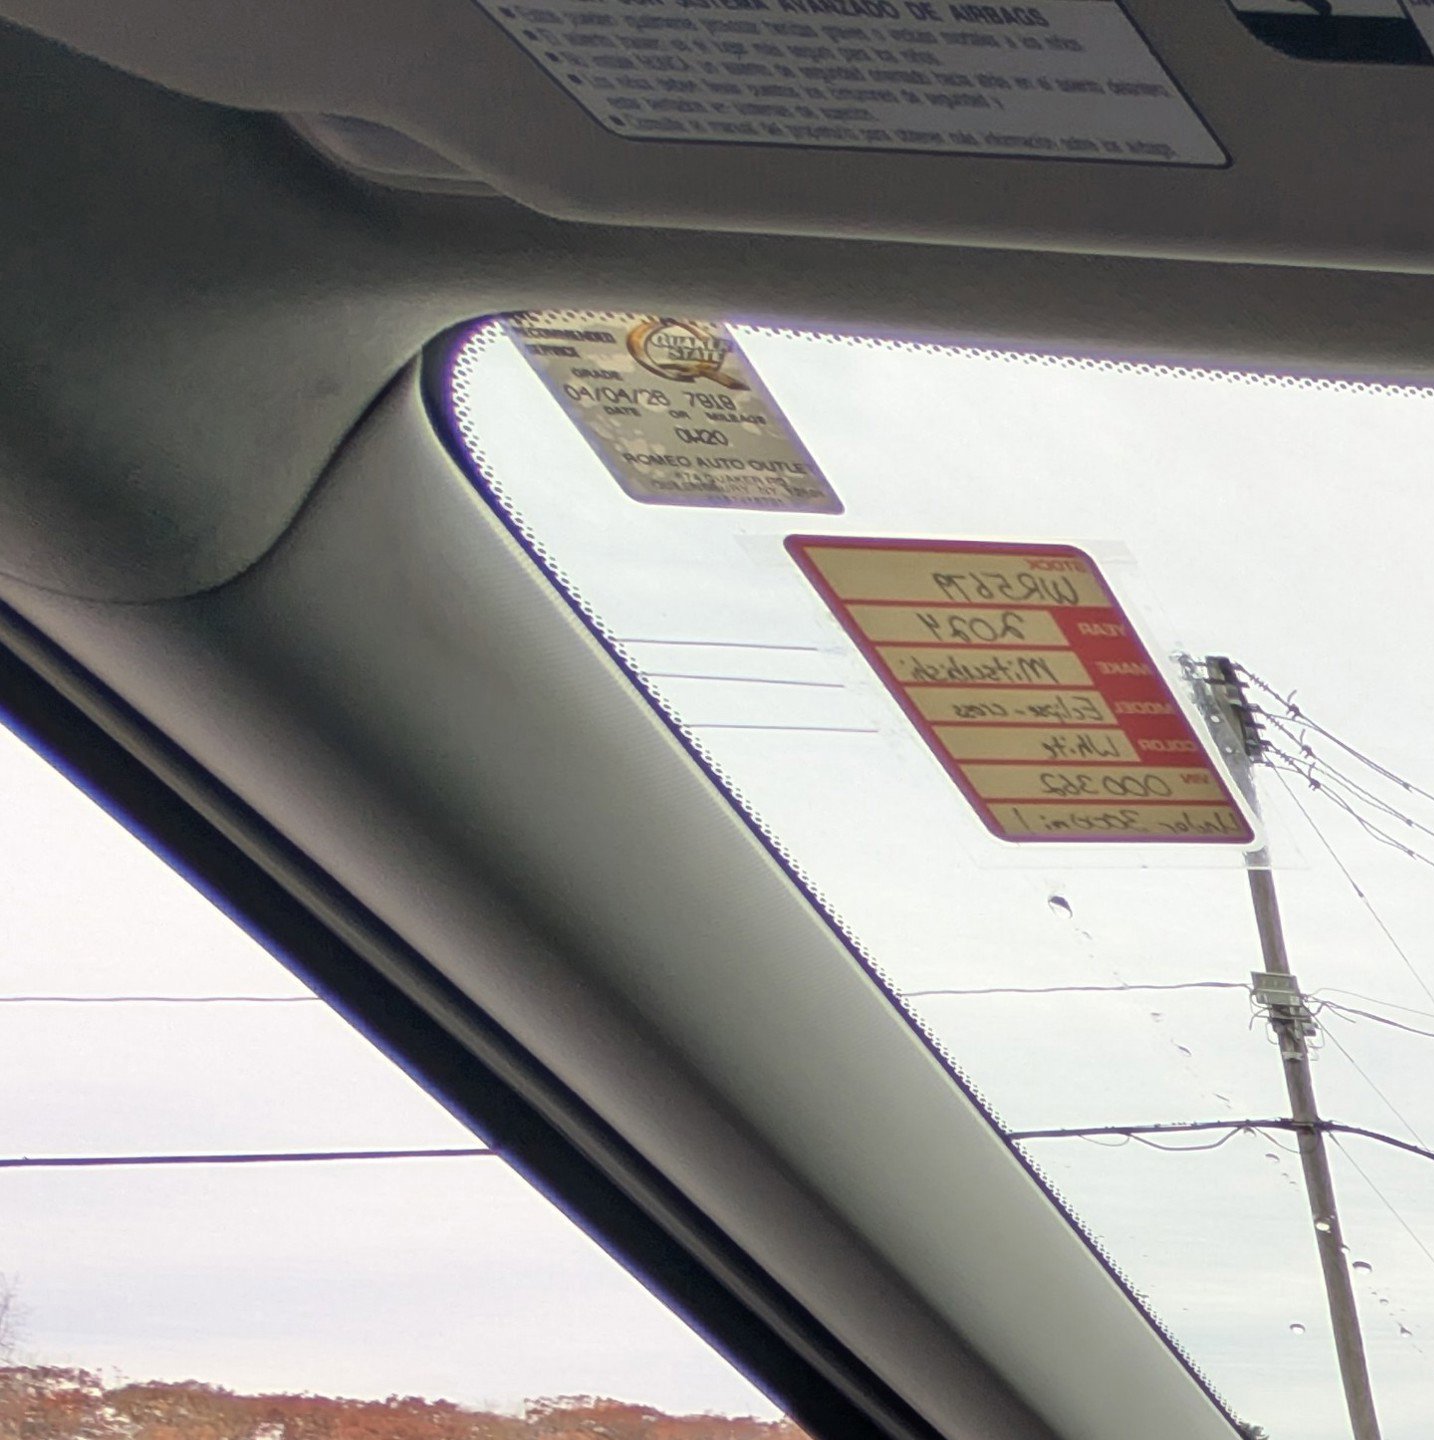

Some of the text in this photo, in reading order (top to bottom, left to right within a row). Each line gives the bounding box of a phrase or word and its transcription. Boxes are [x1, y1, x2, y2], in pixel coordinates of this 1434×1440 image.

[903, 2, 941, 21] DE
[950, 5, 1050, 28] AIRBAGS
[571, 367, 624, 381] GRADE
[602, 406, 768, 426] DATE OR MILEAGE
[621, 451, 813, 476] ROMEO AUTO OUTLE
